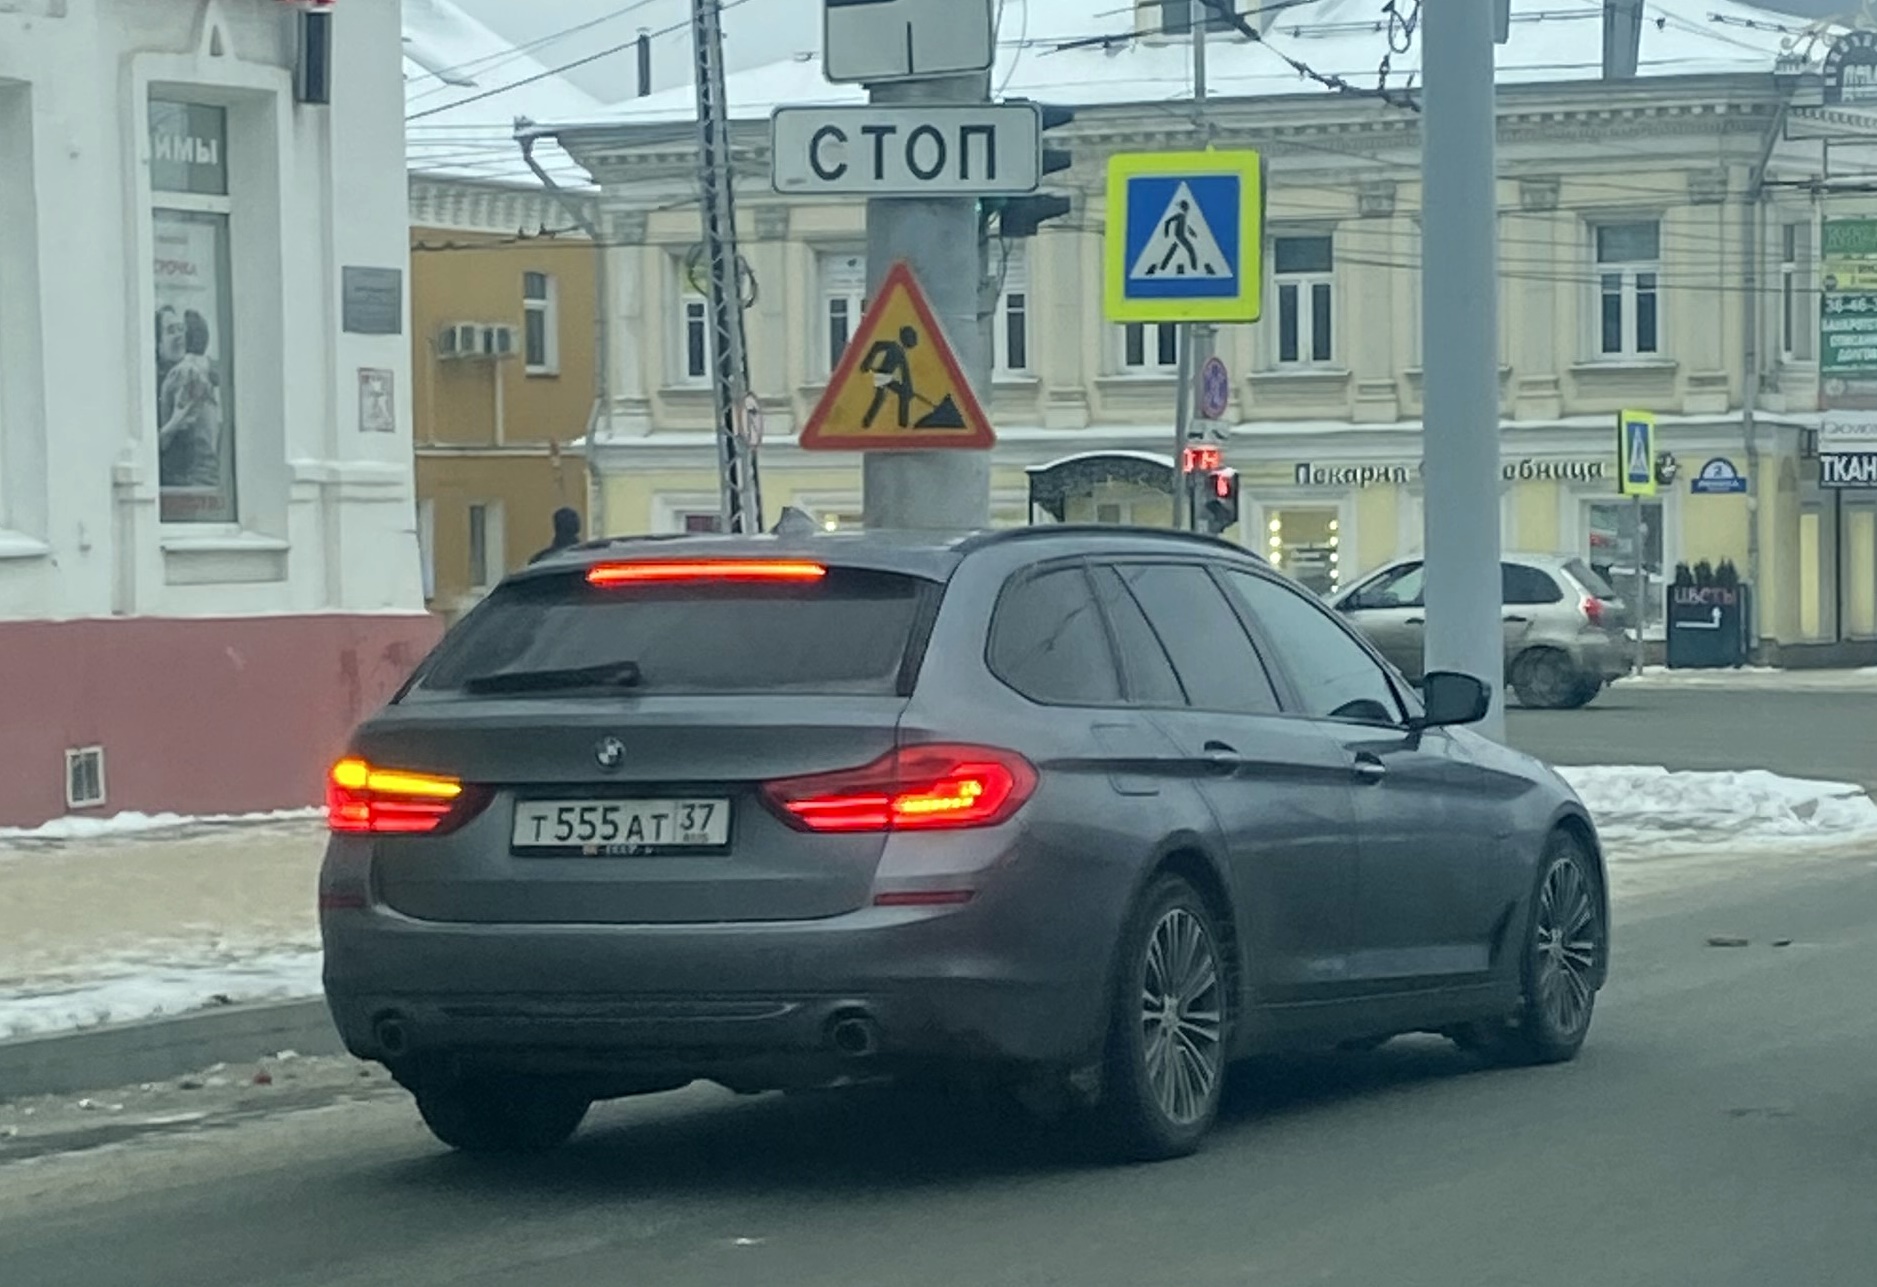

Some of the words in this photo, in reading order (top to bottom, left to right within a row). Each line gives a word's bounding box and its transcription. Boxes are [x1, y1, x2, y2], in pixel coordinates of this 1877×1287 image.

[809, 124, 996, 181] СТОП
[1295, 462, 1411, 488] Пекарня
[680, 803, 715, 831] 37
